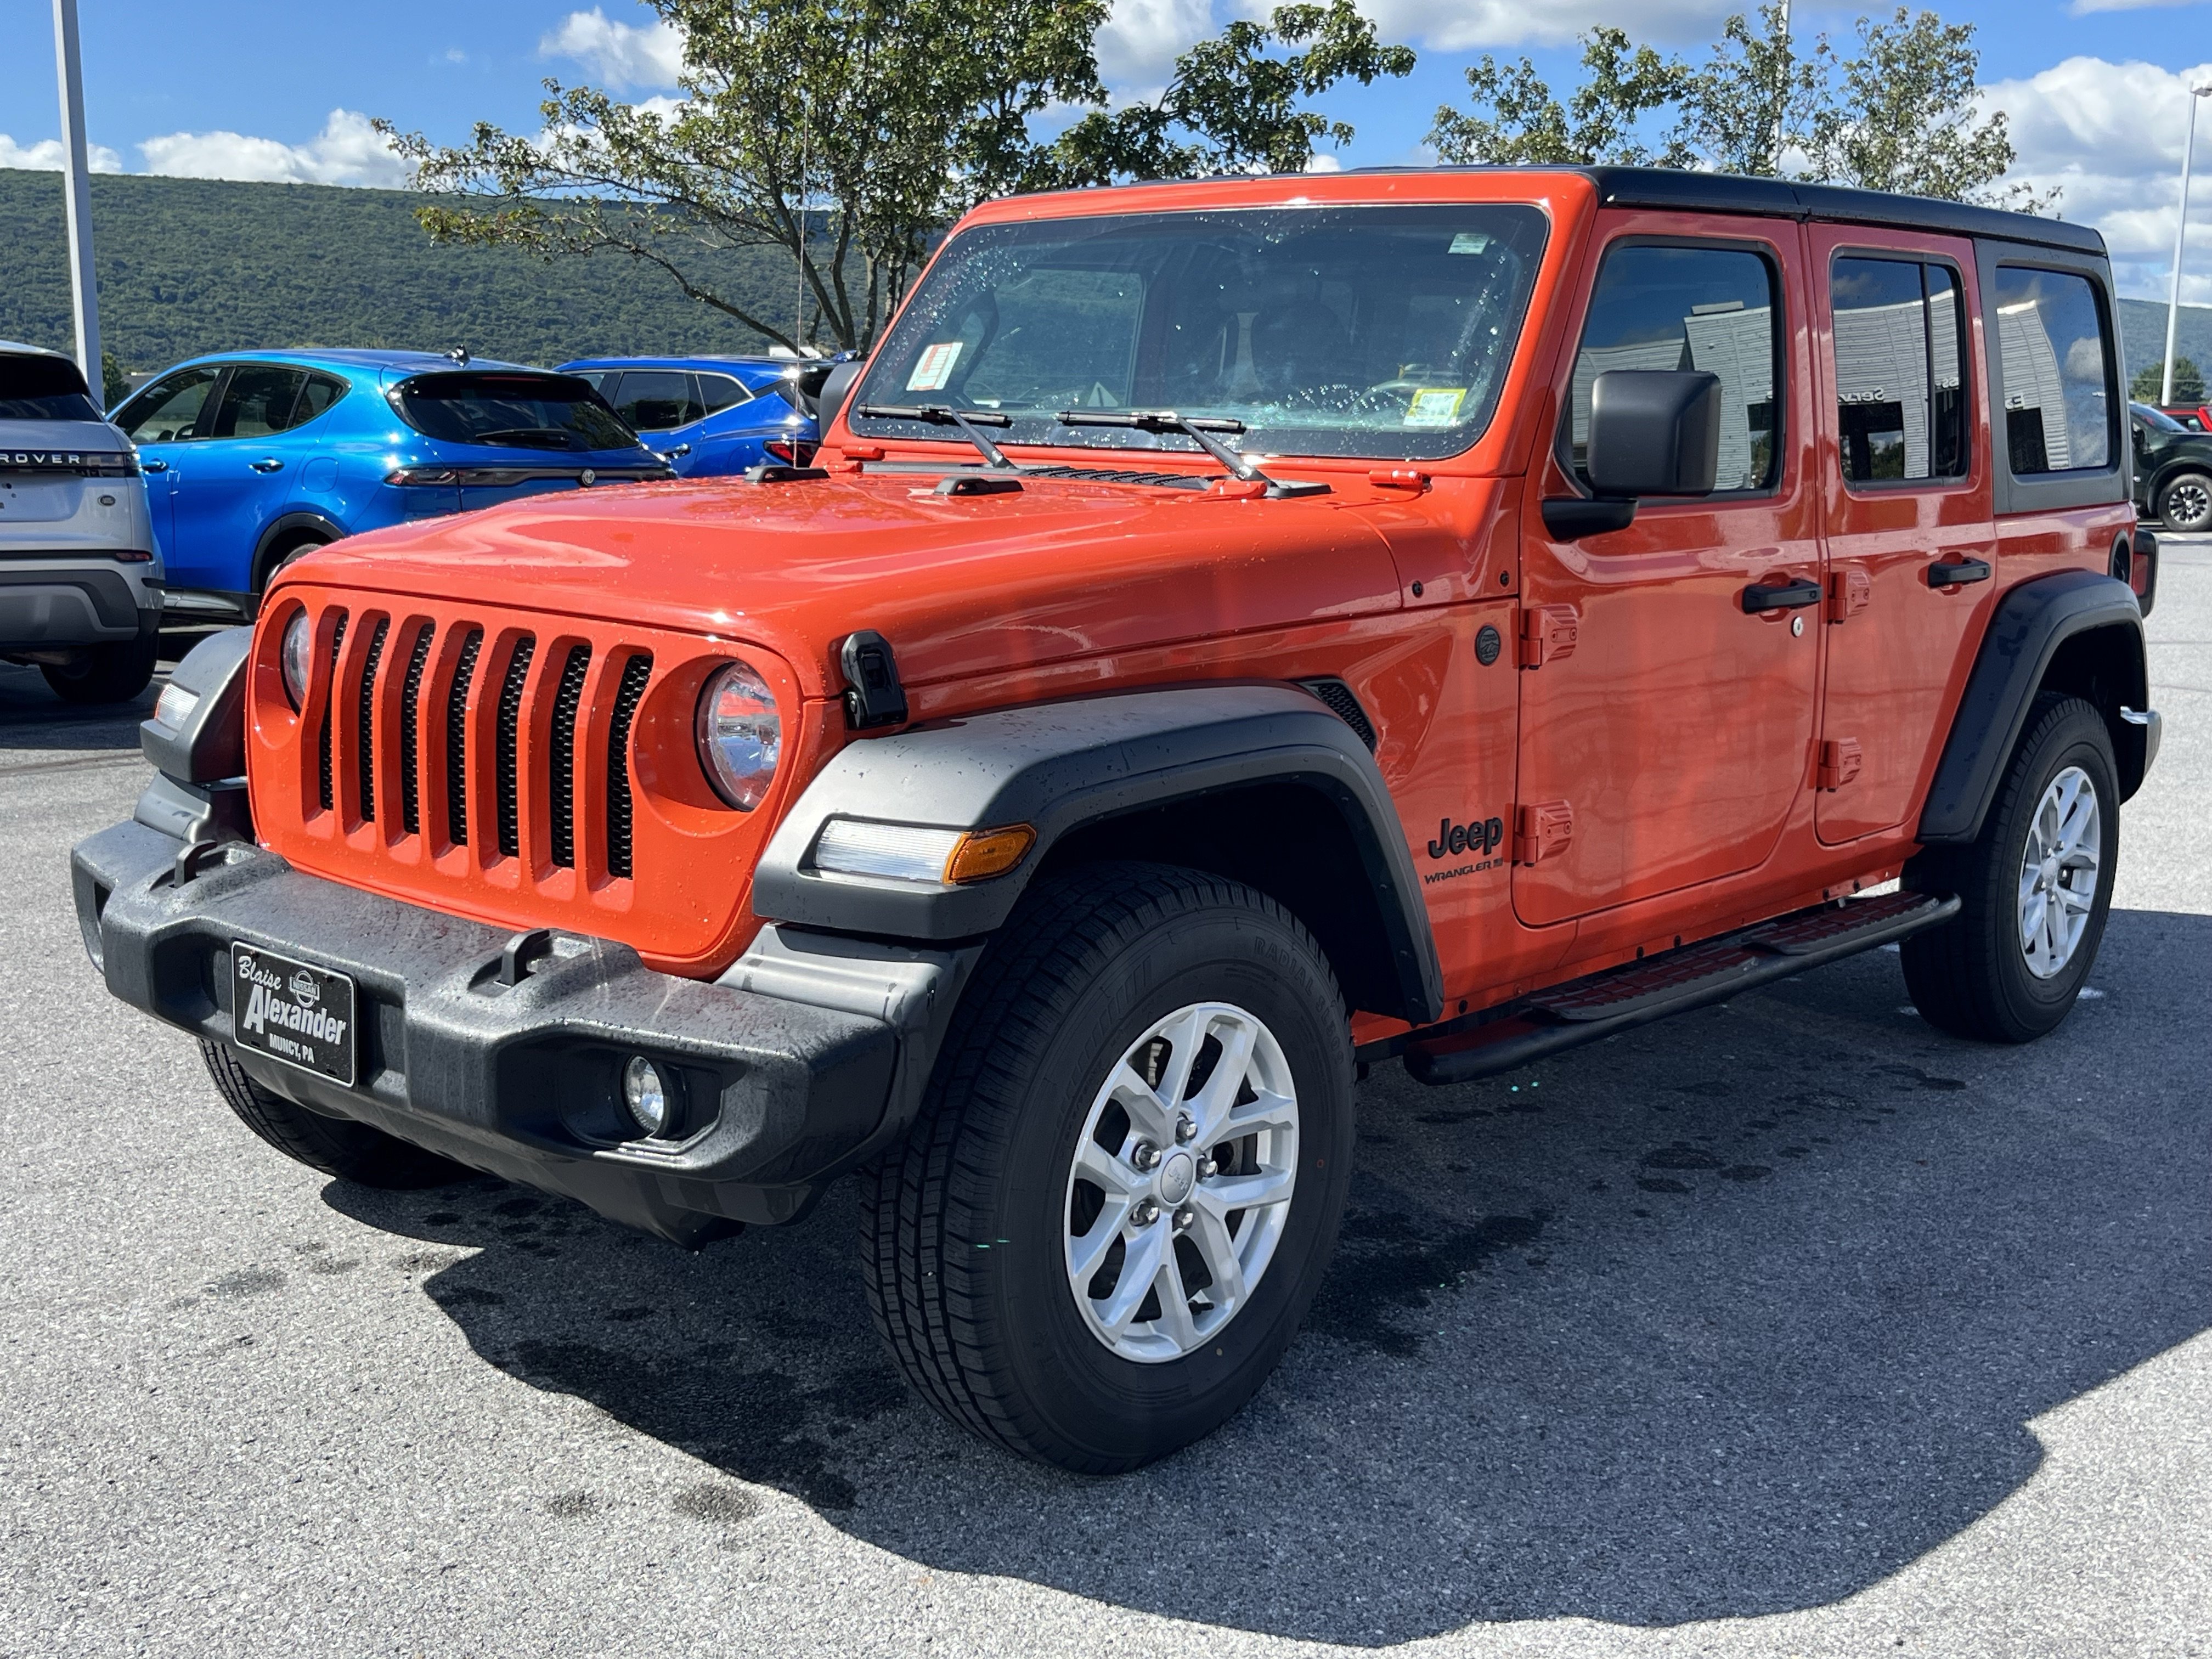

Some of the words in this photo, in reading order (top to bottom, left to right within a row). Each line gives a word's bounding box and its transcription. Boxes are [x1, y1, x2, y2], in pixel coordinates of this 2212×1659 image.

[0, 453, 81, 464] ROVER
[1427, 817, 1503, 859] Jeep
[1424, 861, 1491, 884] WRANGLER
[238, 955, 282, 990] Blaise
[1254, 936, 1313, 996] RADIAL
[243, 984, 347, 1045] Alexander
[269, 1033, 301, 1061] MUNCY,
[302, 1044, 315, 1063] PA
